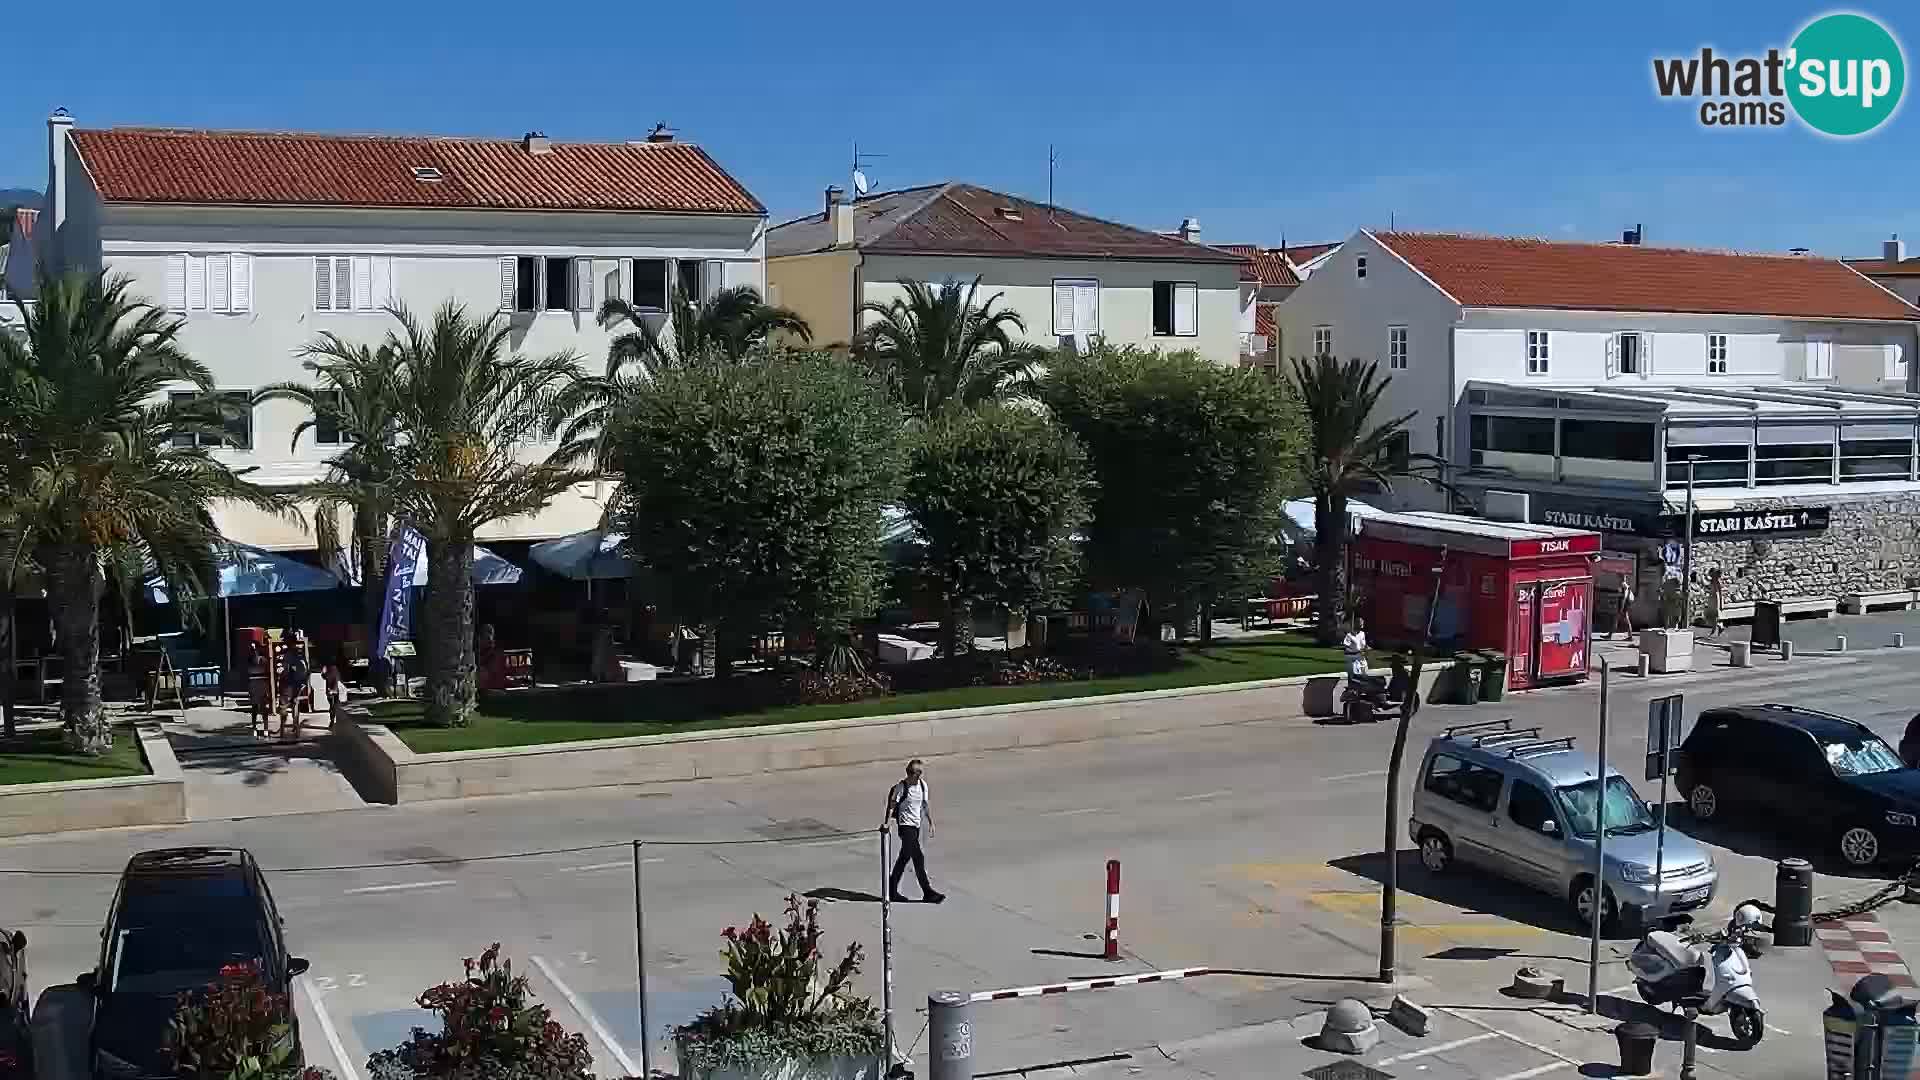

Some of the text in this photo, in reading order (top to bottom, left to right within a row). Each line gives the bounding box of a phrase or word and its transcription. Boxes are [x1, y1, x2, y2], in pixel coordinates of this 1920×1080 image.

[1544, 510, 1583, 527] STARI
[1699, 518, 1741, 533] STARI
[1744, 514, 1797, 531] KAŠTEL
[1540, 539, 1570, 554] TISAK
[1569, 649, 1583, 668] A1
